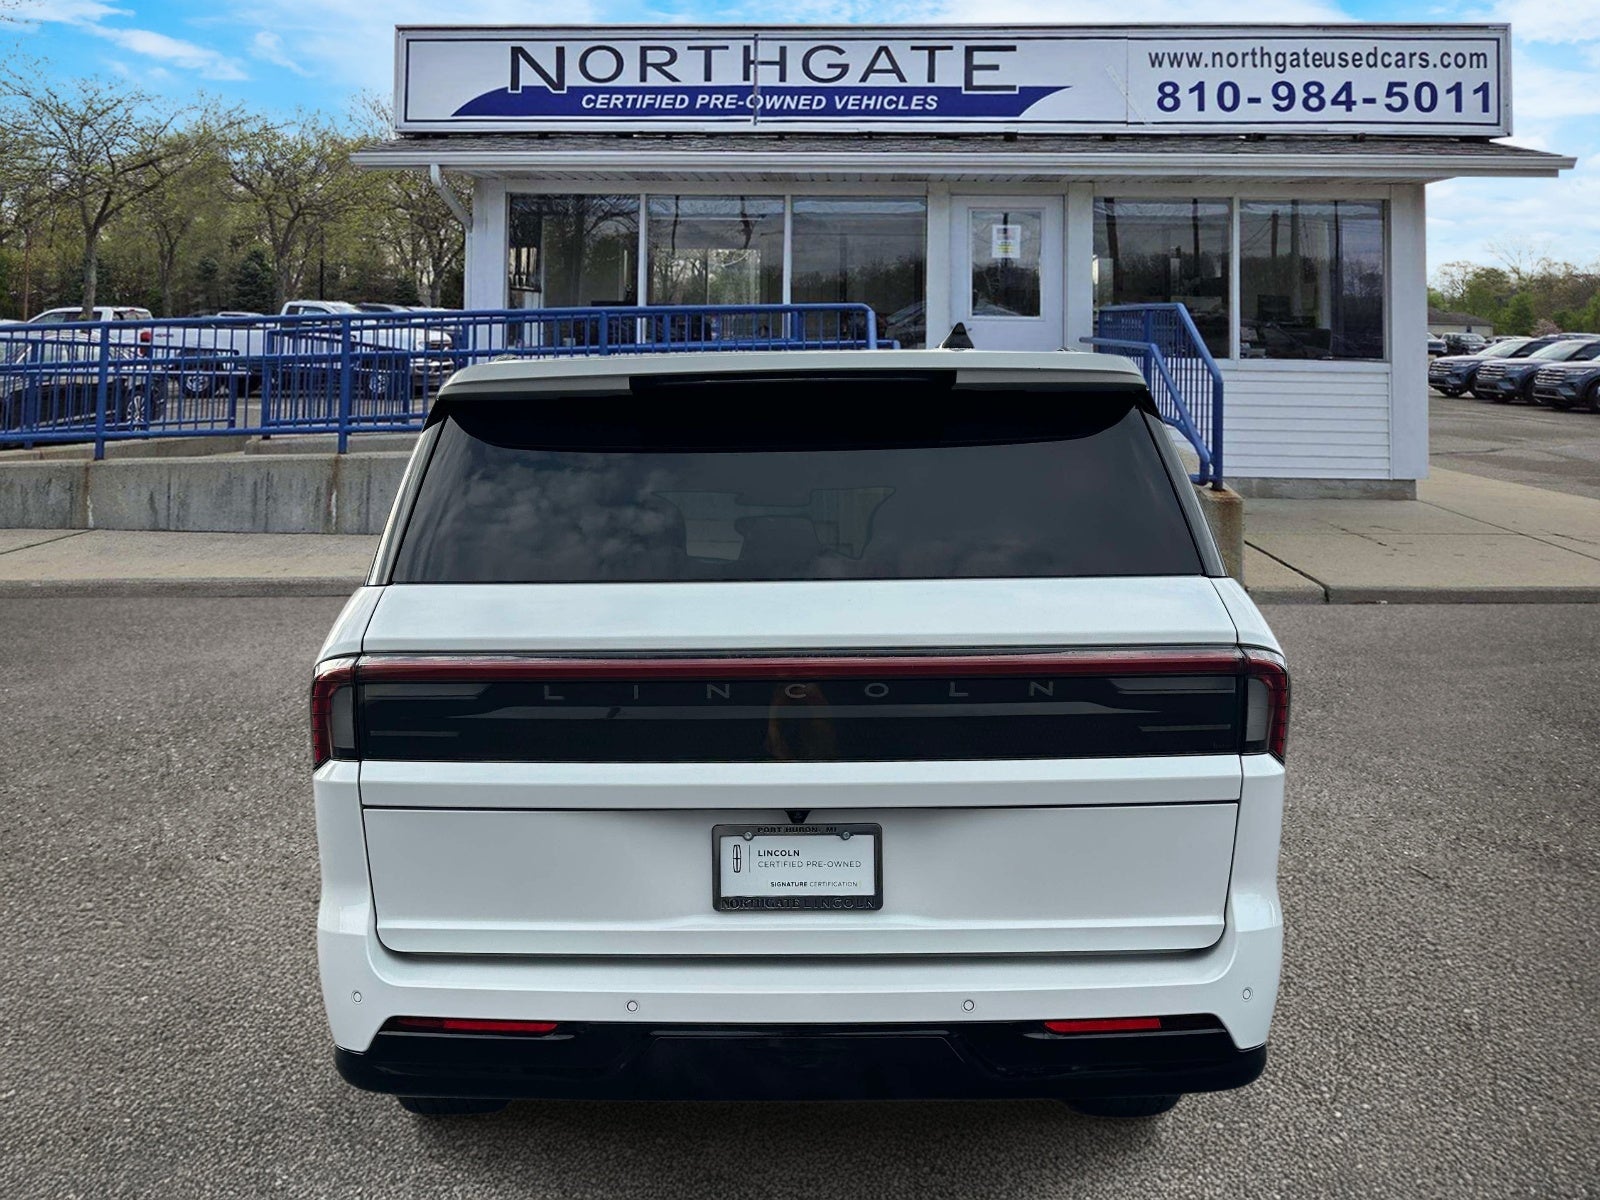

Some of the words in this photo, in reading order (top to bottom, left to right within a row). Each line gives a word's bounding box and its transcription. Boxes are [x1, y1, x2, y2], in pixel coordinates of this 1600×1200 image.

[508, 45, 1019, 93] NORTHGATE
[1148, 46, 1488, 73] www.northgateusedcars.com
[581, 94, 689, 110] CERTIFIED
[695, 94, 827, 111] PRE-OWNED
[833, 95, 939, 111] VEHICLES
[1156, 80, 1490, 113] 810-984-5011
[543, 680, 1055, 701] LINCOLN
[757, 849, 800, 857] LINCOLN
[757, 860, 803, 868] CERTIFIED
[806, 860, 862, 868] PRE-OWNED
[721, 899, 800, 909] NORTHGATE
[803, 898, 876, 909] LINCOLN
